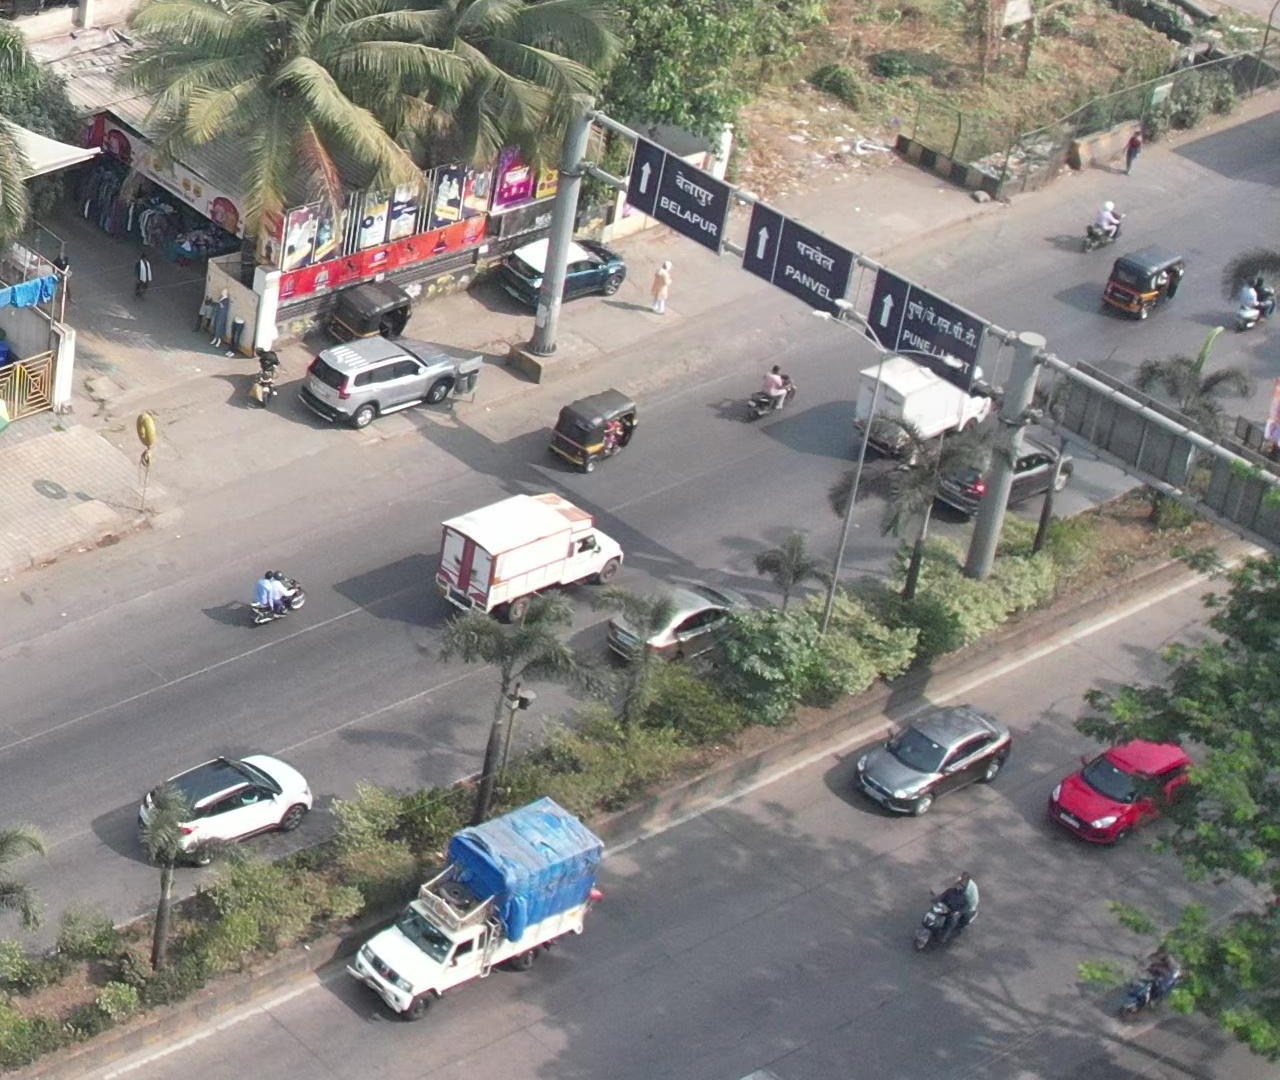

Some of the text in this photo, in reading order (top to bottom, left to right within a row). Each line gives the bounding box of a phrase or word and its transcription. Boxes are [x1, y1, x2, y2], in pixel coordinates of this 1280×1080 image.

[660, 196, 718, 236] BELAPUR
[797, 240, 836, 272] पनवेल
[784, 264, 833, 302] PANVEL
